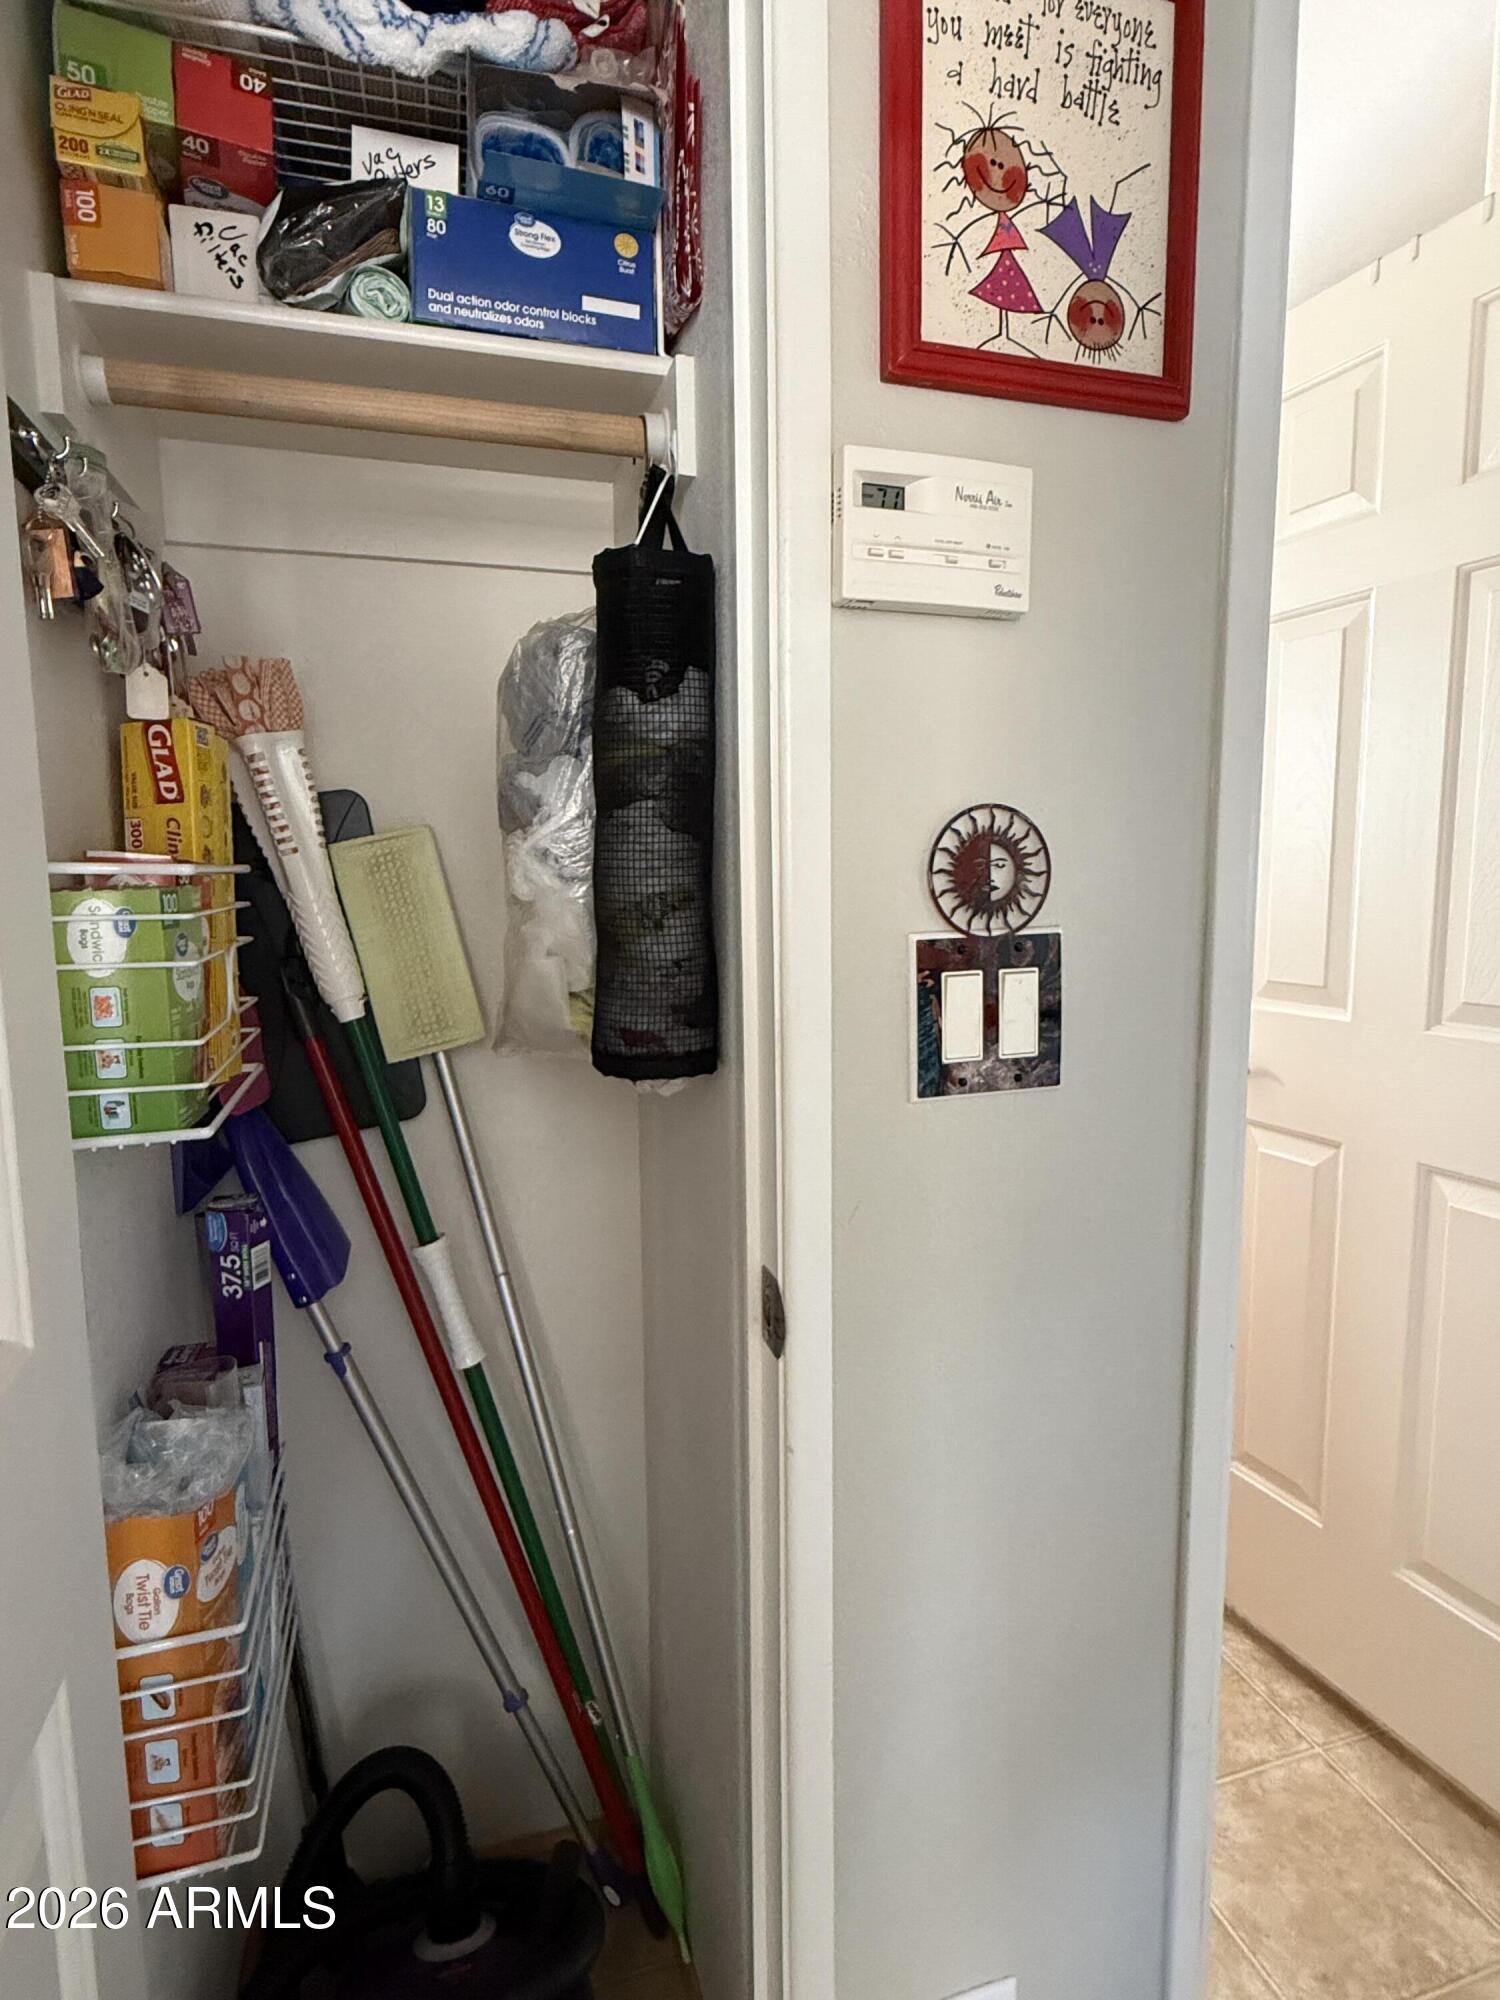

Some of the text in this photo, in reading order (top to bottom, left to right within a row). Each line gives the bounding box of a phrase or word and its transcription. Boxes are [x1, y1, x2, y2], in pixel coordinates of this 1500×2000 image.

[67, 60, 96, 85] 50
[926, 6, 1164, 110] you meet is fighting
[57, 87, 90, 99] GLAD
[239, 74, 267, 94] 40
[988, 56, 1041, 104] hard
[1060, 73, 1121, 127] battle
[59, 136, 89, 154] 200
[182, 135, 209, 155] 40
[75, 189, 97, 223] 100
[425, 195, 445, 212] 13
[485, 185, 510, 199] 60
[426, 218, 447, 235] 80
[427, 287, 598, 326] Dual action odor control blocks
[428, 302, 545, 330] and neutralizes odors
[147, 724, 179, 800] GLAD
[129, 819, 143, 850] 300
[165, 817, 182, 856] Clin
[88, 905, 105, 964] Sndwic
[220, 1254, 243, 1299] 37.5
[135, 1573, 152, 1631] Twist Tie
